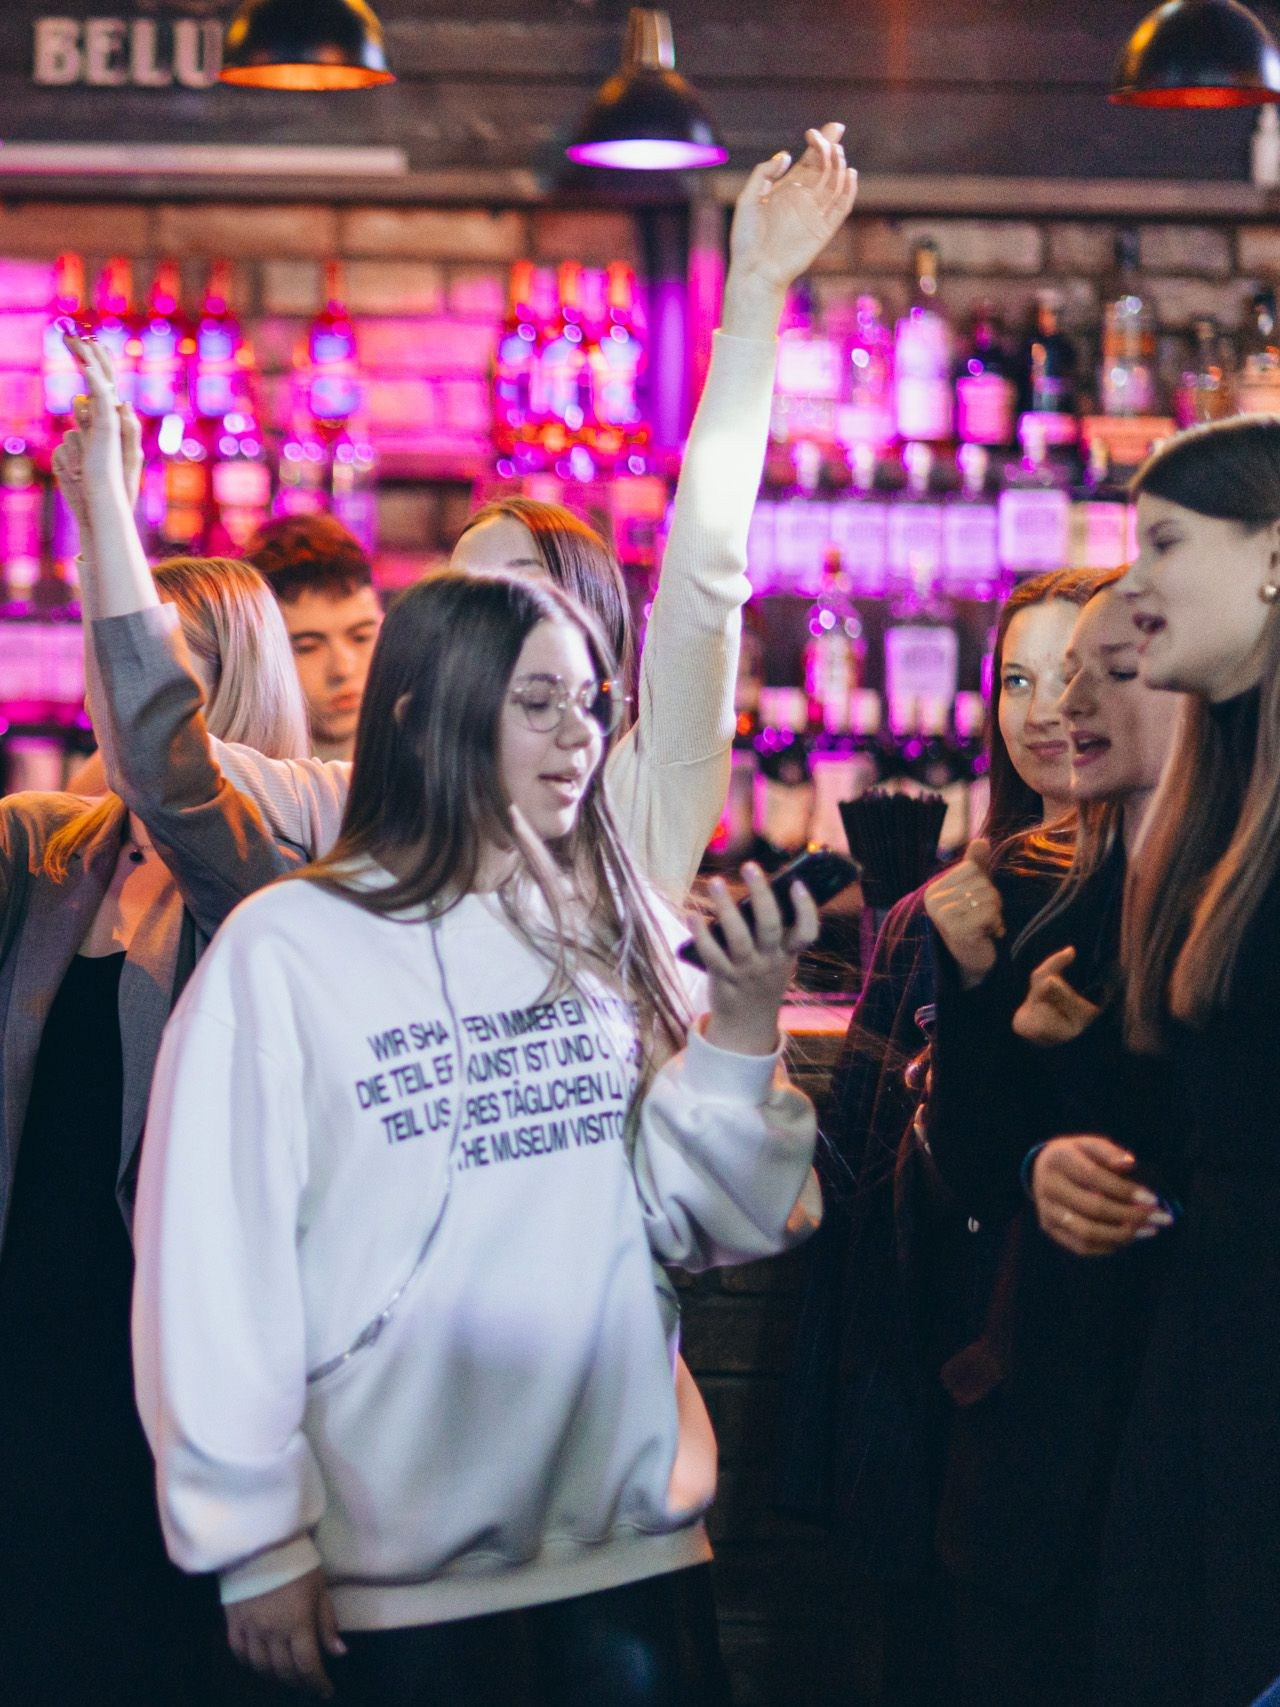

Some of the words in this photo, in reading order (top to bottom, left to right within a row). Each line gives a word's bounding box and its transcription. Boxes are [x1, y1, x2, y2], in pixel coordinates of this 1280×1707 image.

[366, 1027, 411, 1062] WIR
[496, 1002, 563, 1038] IMMER
[356, 1073, 391, 1110] DIE
[389, 1062, 434, 1098] TEIL
[521, 1040, 550, 1072] IST
[551, 1033, 594, 1067] UND
[381, 1107, 425, 1145] TEIL
[501, 1071, 605, 1119] TÄGLICHEN
[457, 1135, 490, 1171] HE
[489, 1120, 569, 1163] MUSEUM
[568, 1110, 625, 1148] VISITO
